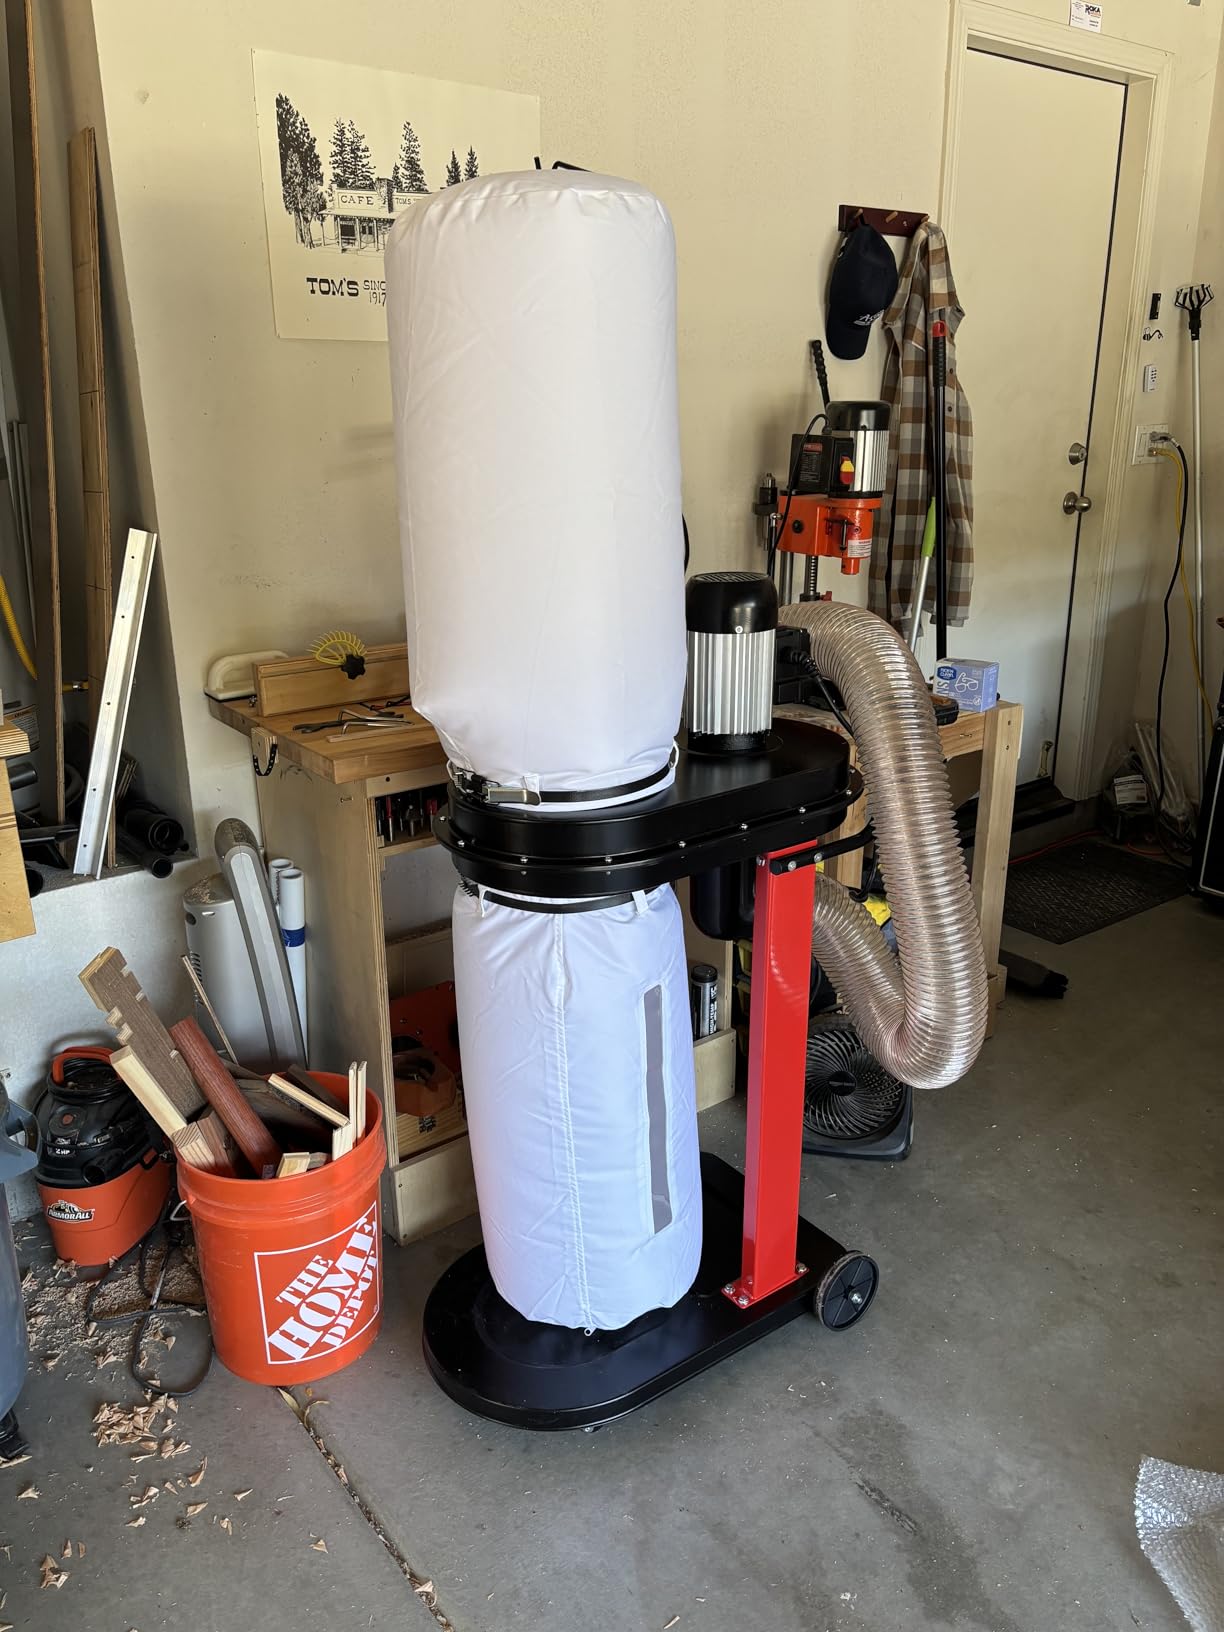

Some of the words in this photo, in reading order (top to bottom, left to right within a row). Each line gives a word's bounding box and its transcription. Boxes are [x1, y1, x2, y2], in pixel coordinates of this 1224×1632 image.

[340, 195, 374, 206] CAFE
[306, 277, 359, 297] TOM'S
[363, 280, 386, 292] SINC
[267, 1217, 377, 1360] HOME
[275, 1255, 333, 1307] THE
[321, 1250, 378, 1347] DEPOT
